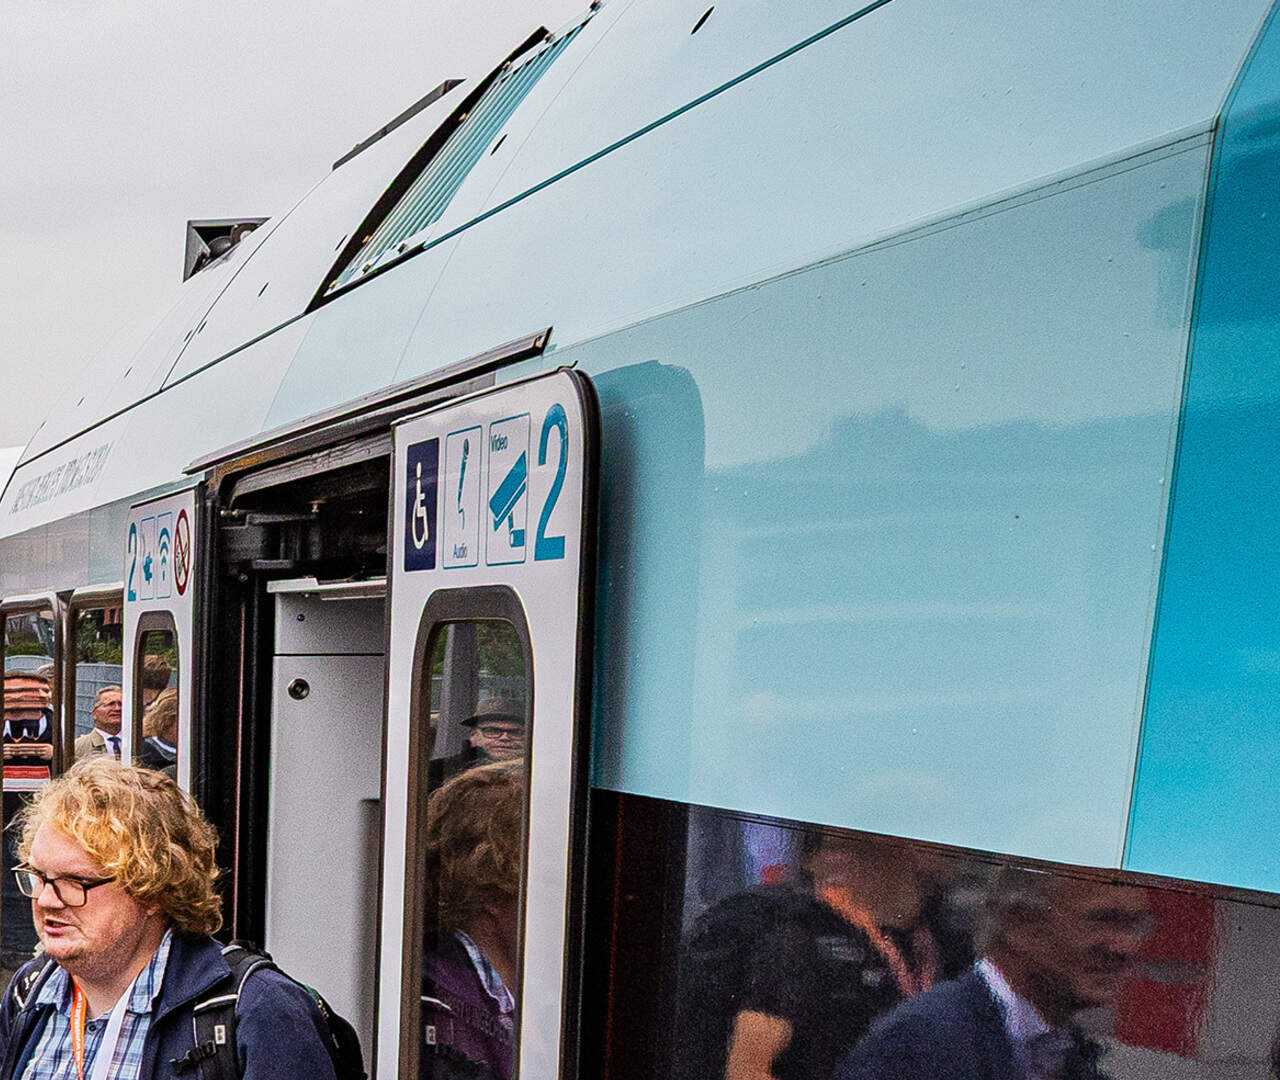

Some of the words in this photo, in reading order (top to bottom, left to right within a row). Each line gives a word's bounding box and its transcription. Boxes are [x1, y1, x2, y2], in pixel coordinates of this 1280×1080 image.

[490, 433, 508, 452] Video
[533, 403, 569, 562] 2
[127, 521, 137, 602] 2
[453, 543, 468, 559] Audio
